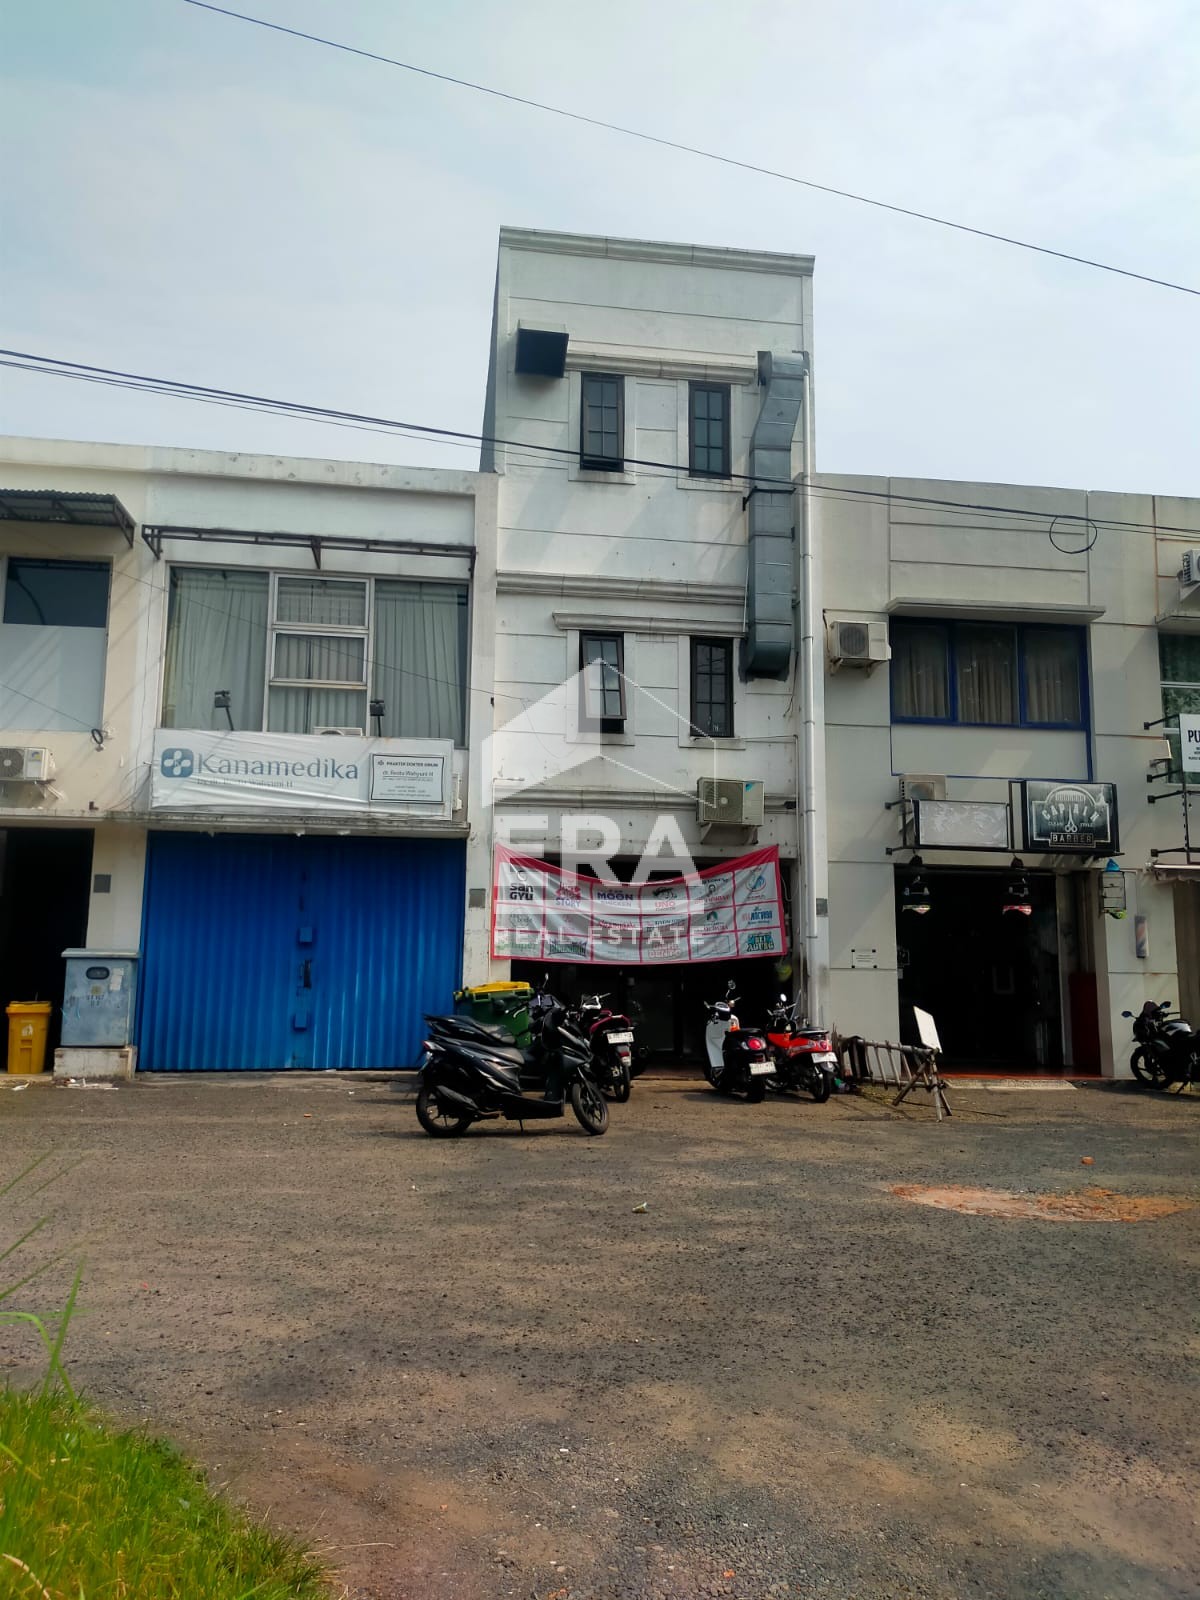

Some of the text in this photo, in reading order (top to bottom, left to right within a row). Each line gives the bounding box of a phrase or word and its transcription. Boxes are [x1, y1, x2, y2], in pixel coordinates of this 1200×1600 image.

[198, 753, 358, 779] Kanamedika
[1041, 803, 1100, 822] CAPAIN
[1052, 834, 1092, 843] BARBER
[597, 891, 633, 900] MOON
